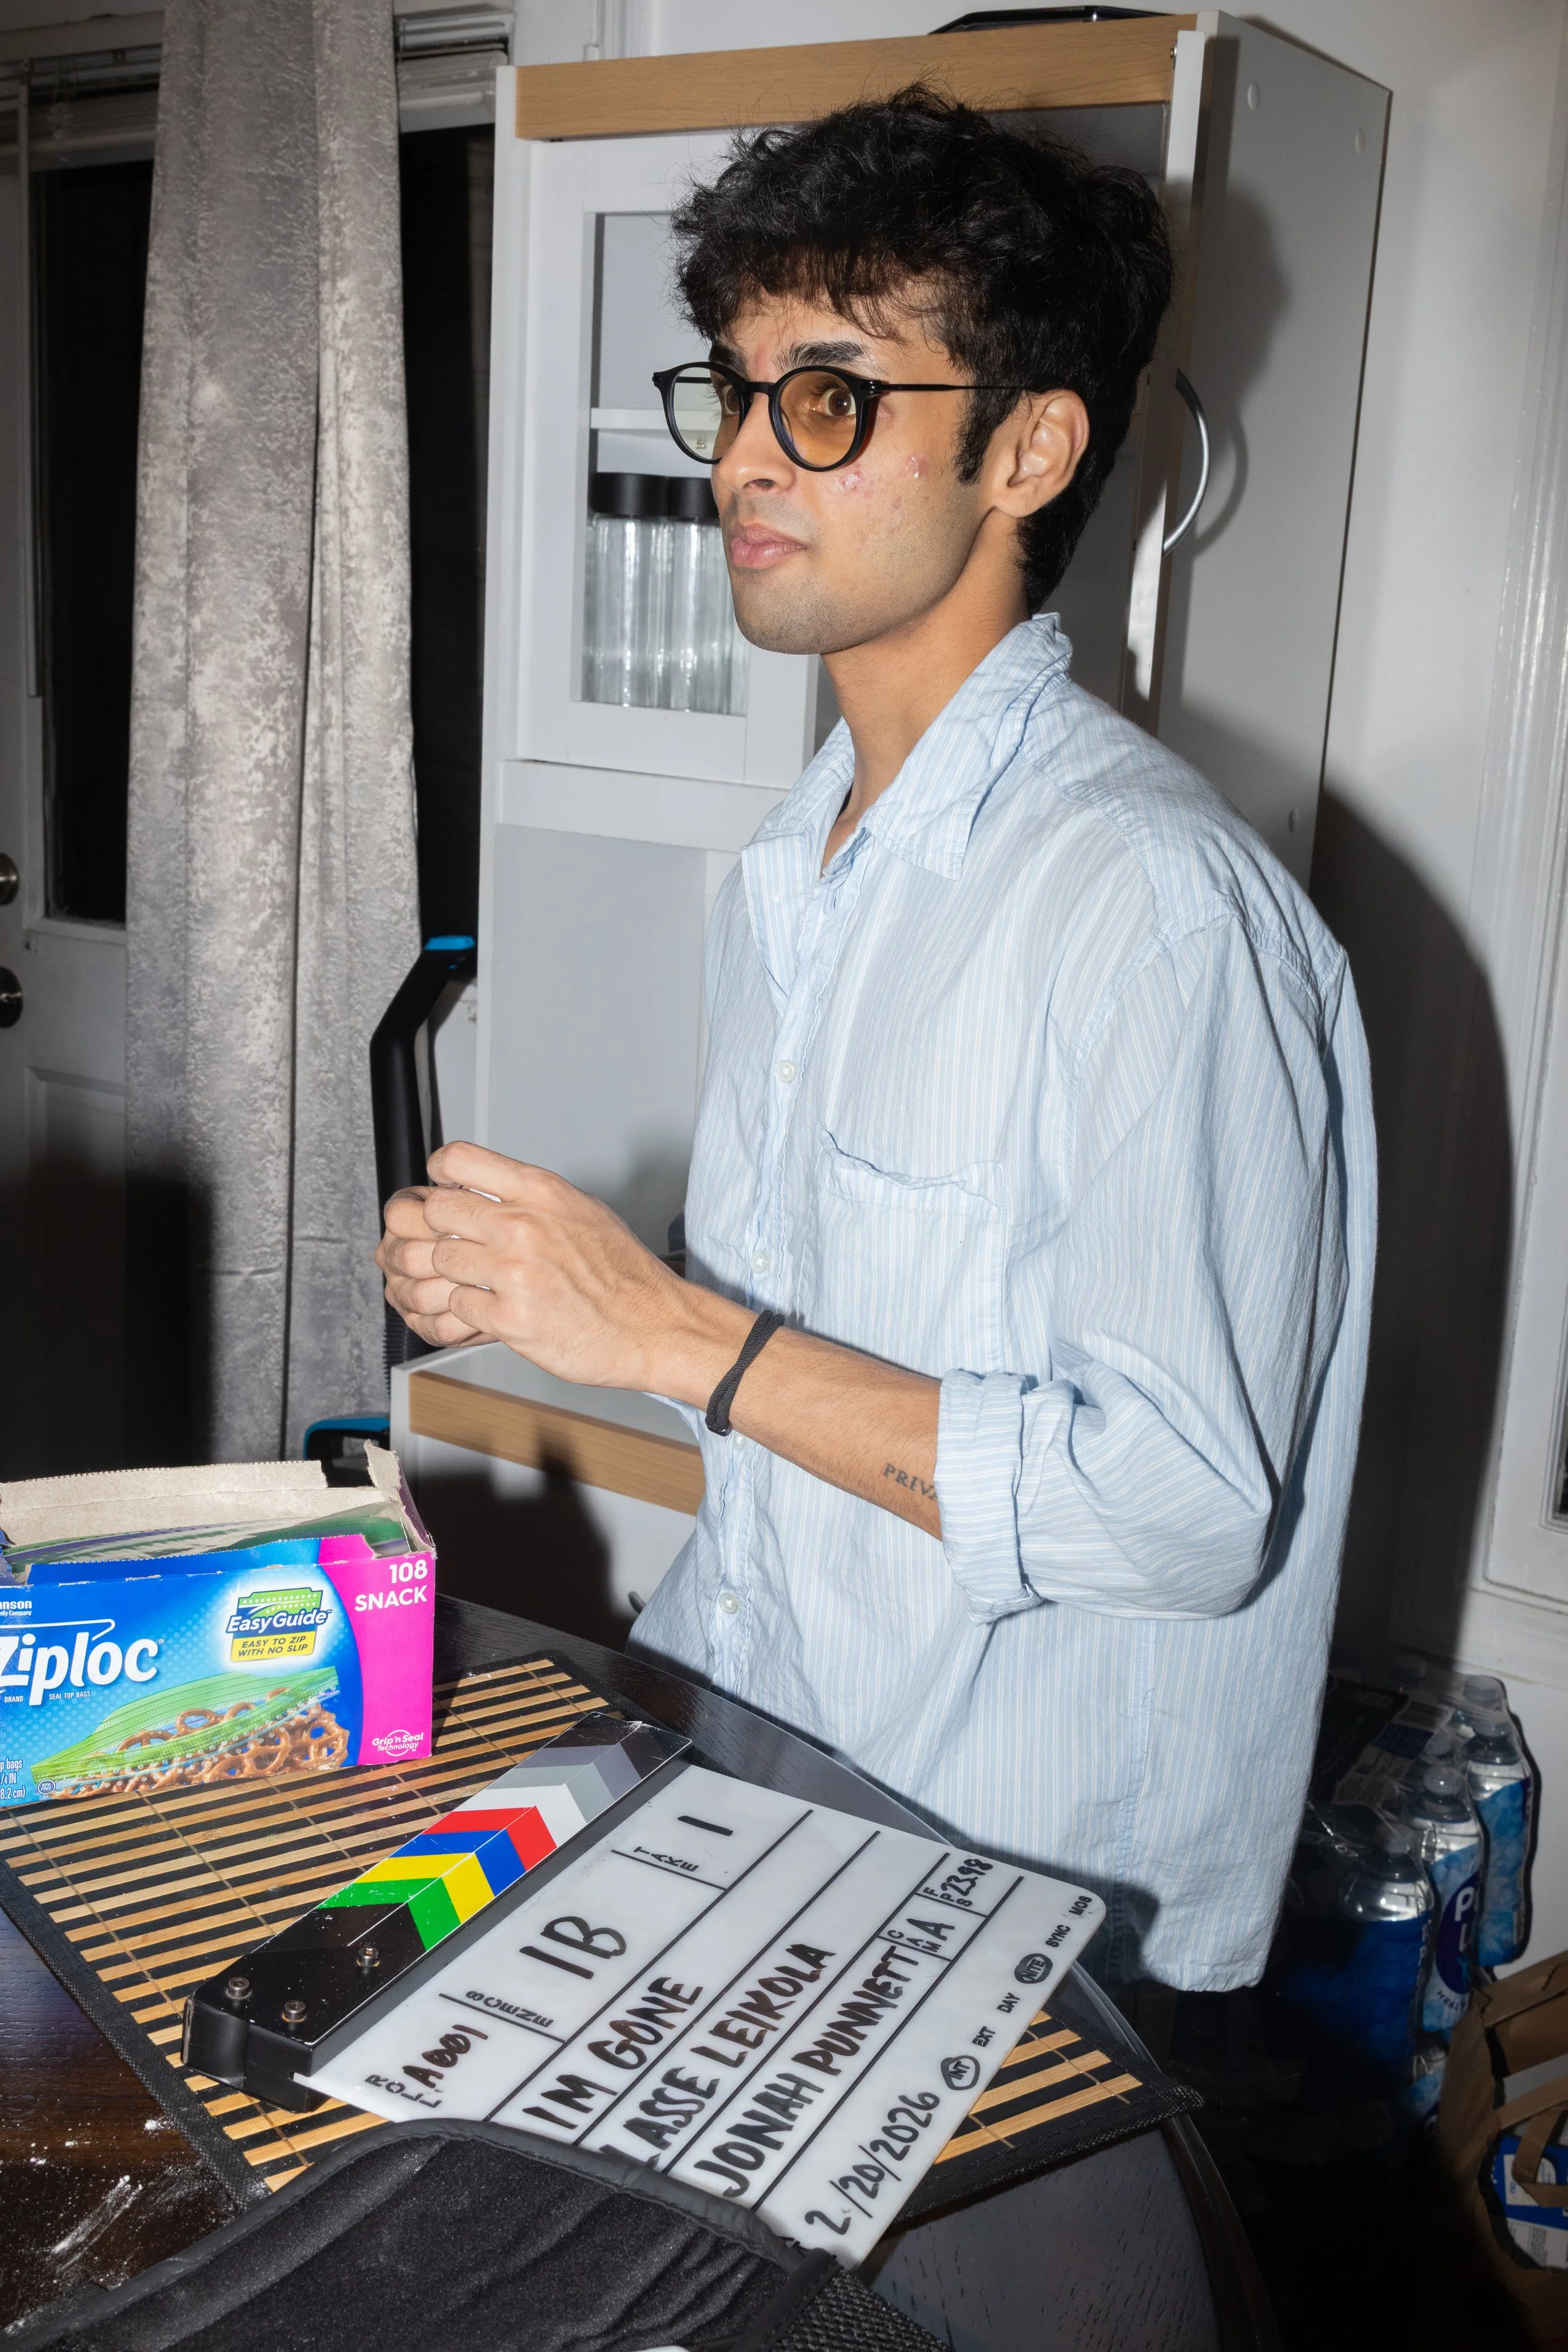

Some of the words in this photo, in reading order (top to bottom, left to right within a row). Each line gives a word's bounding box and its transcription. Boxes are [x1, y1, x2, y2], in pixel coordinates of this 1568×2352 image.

[389, 1559, 428, 1584] 108
[354, 1585, 428, 1612] SNACK
[238, 1648, 264, 1657] WITH
[287, 1644, 308, 1652] SLIP
[241, 1640, 269, 1648] EASY
[289, 1636, 306, 1644] ZIP
[372, 1737, 394, 1745] Grip
[402, 1732, 424, 1742] Seal
[378, 1742, 419, 1752] Technology
[6, 1757, 23, 1772] bags
[9, 1772, 16, 1784] IN
[13, 1785, 25, 1799] cm)
[633, 1846, 699, 1872] TAKE
[923, 1886, 973, 1907] FPS
[887, 1929, 942, 1952] CAM
[906, 1918, 955, 1941] A
[948, 2060, 970, 2080] INT
[972, 2026, 996, 2047] EXT
[997, 1992, 1020, 2013] DAY
[1021, 1958, 1047, 1982] NITE
[1046, 1924, 1071, 1947] SYNC
[1069, 1895, 1093, 1916] MOS
[465, 1989, 554, 2028] SCENE
[690, 1943, 837, 2069] LEIKOLA
[587, 1976, 704, 2070] GONE
[694, 2072, 825, 2198] JONAH
[791, 1945, 919, 2076] PUNNETT
[365, 2074, 442, 2108] ROLL
[804, 2092, 940, 2235] 2/20/2026
